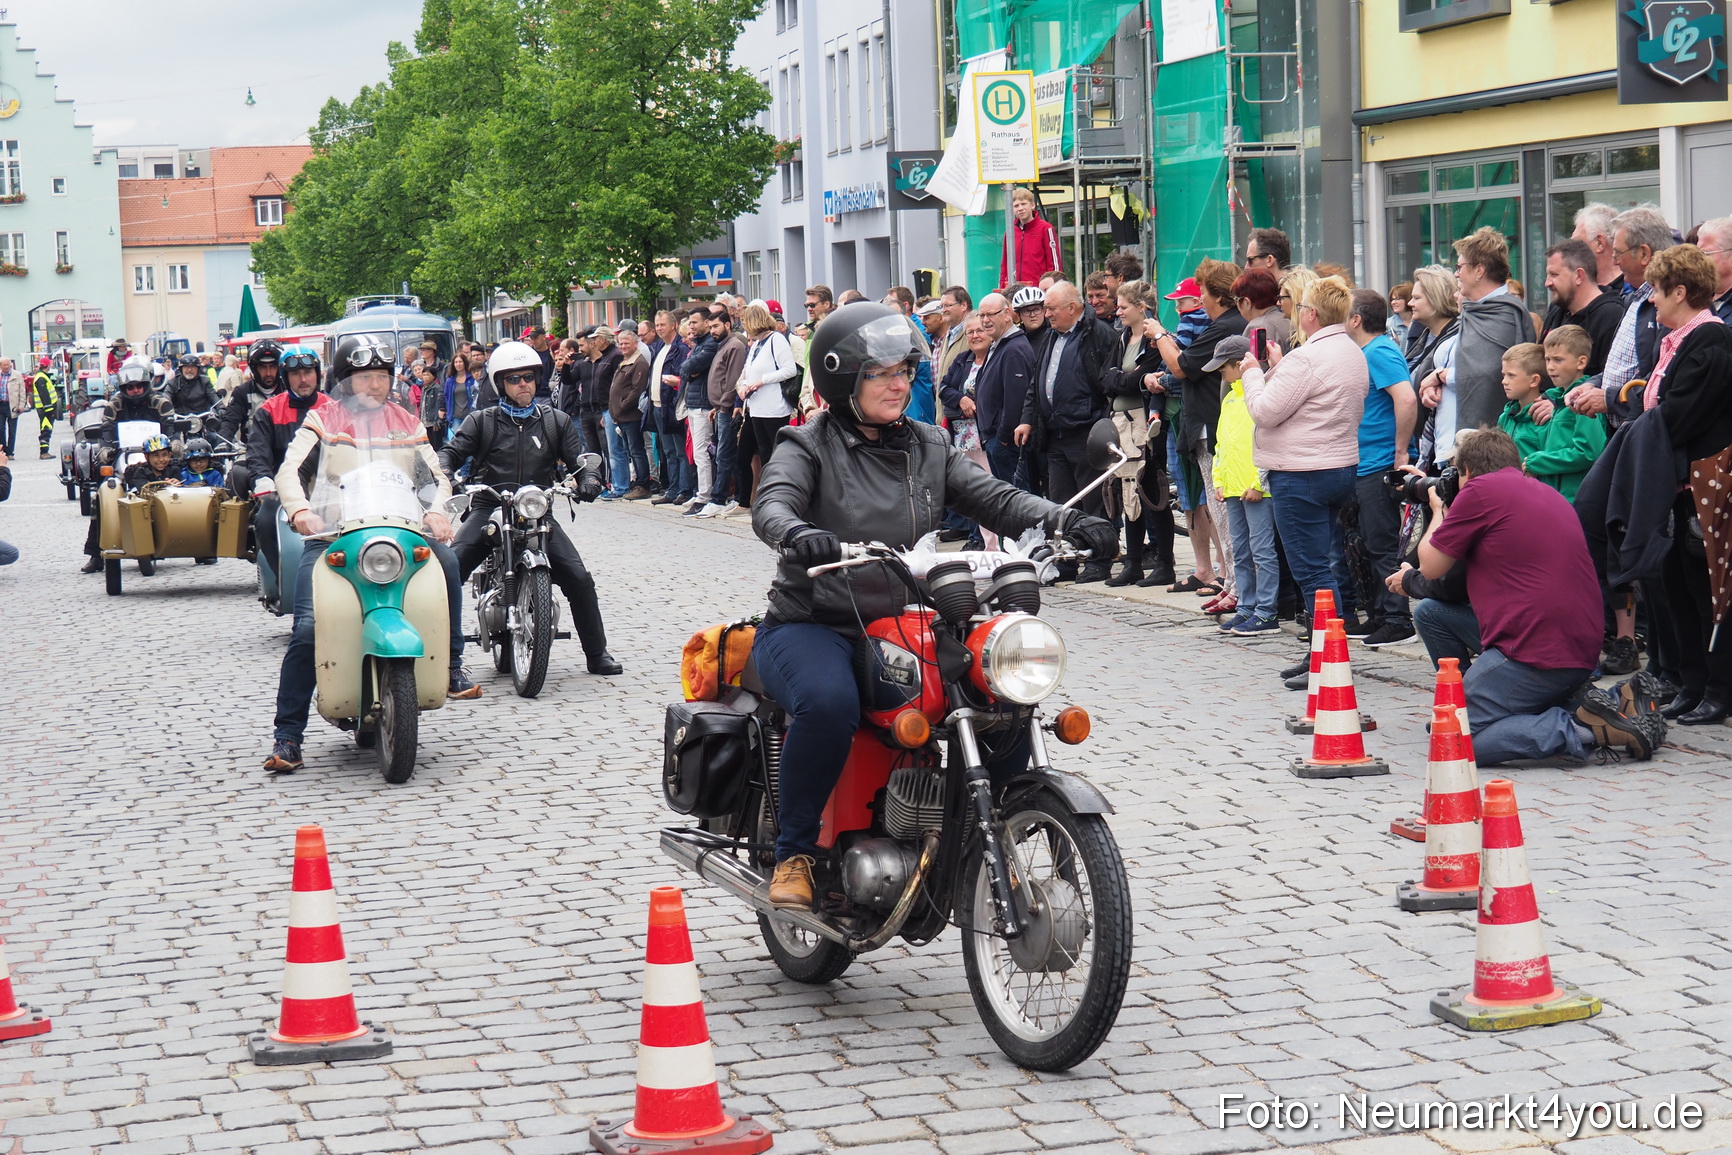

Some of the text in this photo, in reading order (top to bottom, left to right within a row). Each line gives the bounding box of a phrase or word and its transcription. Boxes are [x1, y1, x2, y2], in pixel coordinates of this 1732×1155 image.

[1662, 17, 1700, 64] G2
[994, 90, 1013, 115] H
[908, 166, 929, 191] G2
[380, 471, 404, 485] 545
[965, 552, 1004, 573] 546
